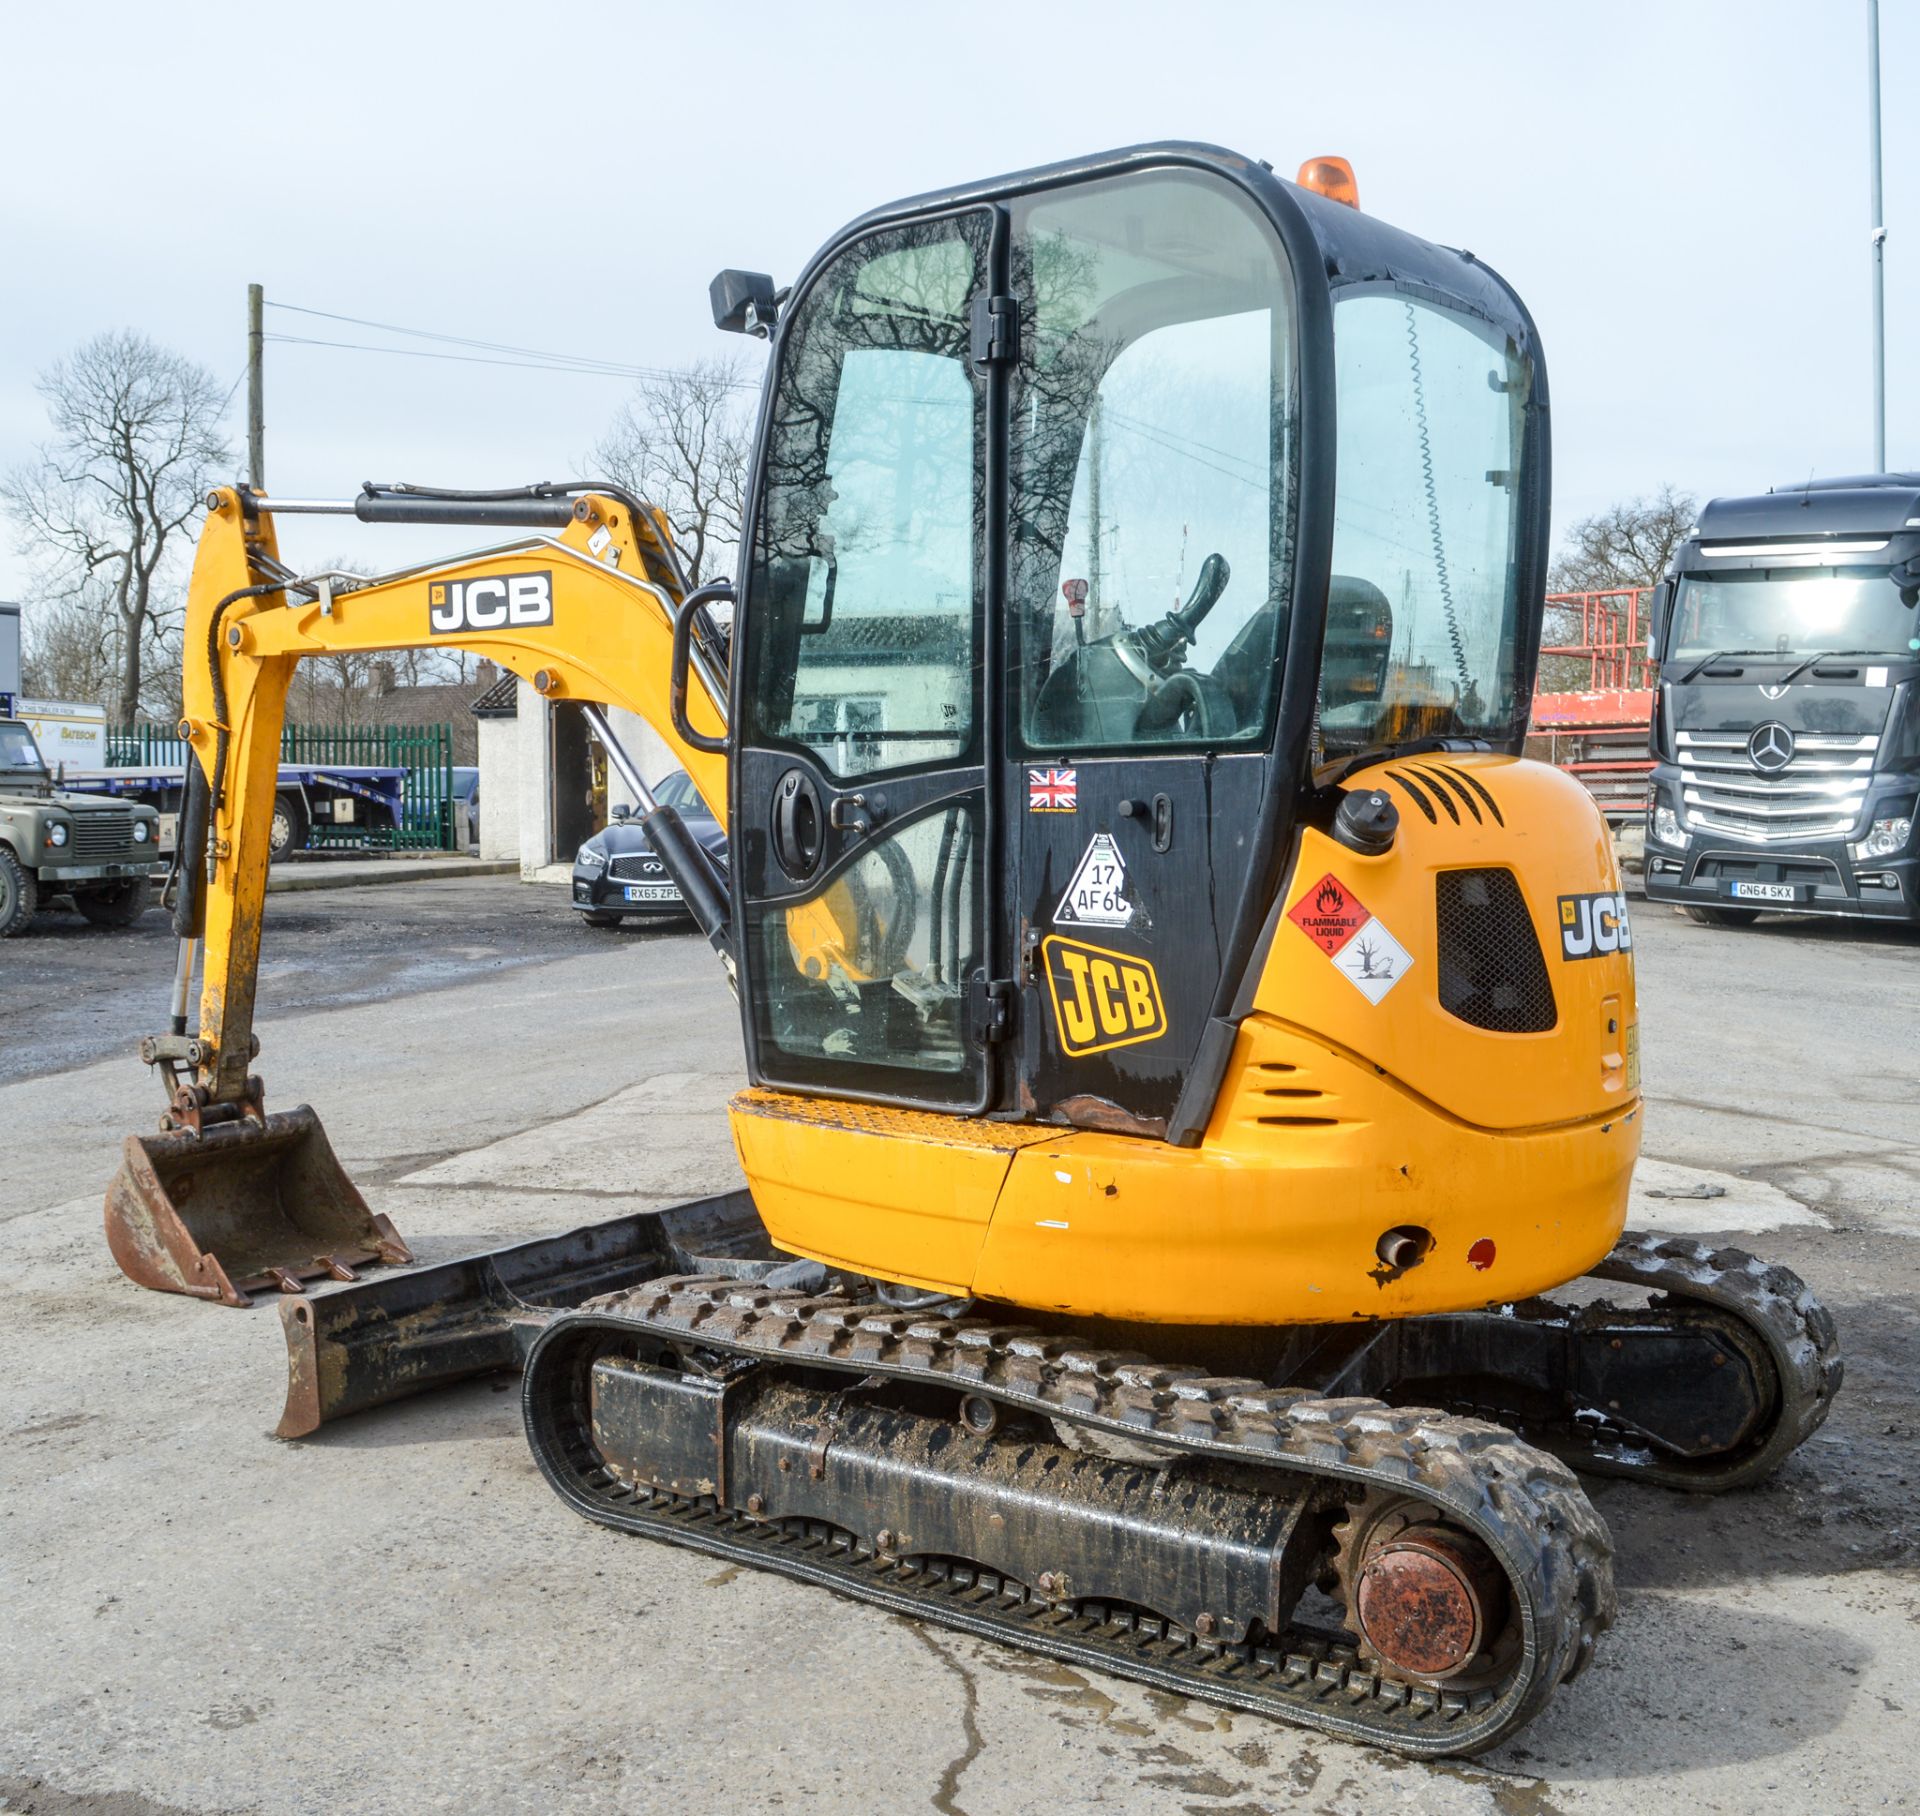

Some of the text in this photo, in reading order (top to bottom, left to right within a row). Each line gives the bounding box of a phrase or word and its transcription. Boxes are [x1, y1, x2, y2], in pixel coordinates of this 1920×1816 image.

[431, 576, 551, 630] JCB
[1092, 865, 1115, 885] 17
[631, 888, 680, 899] RX65 ZPE
[1740, 884, 1792, 898] GN64 SKX
[1302, 918, 1357, 927] FLAMMABLE
[1316, 928, 1344, 937] LIQUID
[1327, 940, 1333, 949] 3
[1061, 950, 1156, 1043] JCB
